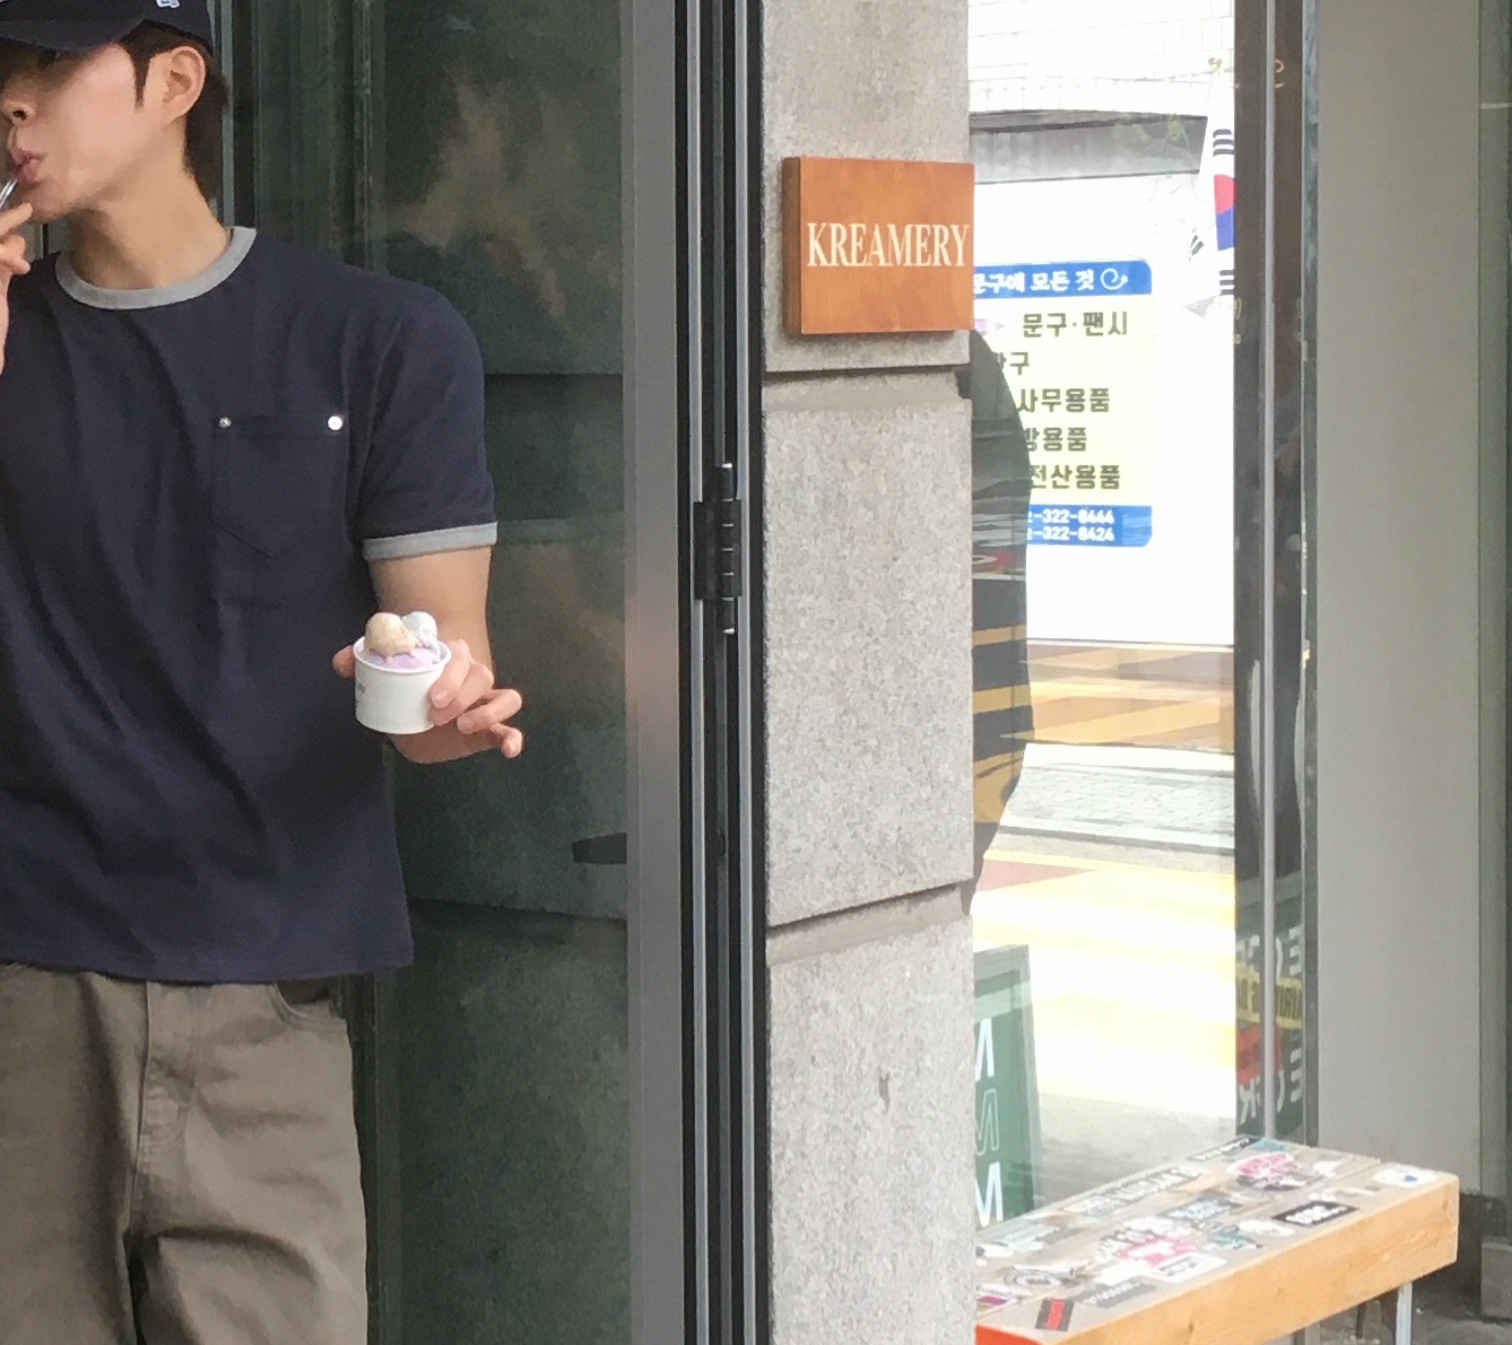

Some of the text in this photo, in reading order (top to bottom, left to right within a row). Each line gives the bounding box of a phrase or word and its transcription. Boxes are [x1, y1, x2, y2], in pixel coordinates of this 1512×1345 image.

[807, 222, 970, 267] KREAMERY
[1030, 272, 1070, 291] 모든
[1075, 269, 1094, 291] 것
[1018, 387, 1110, 413] 사무용품
